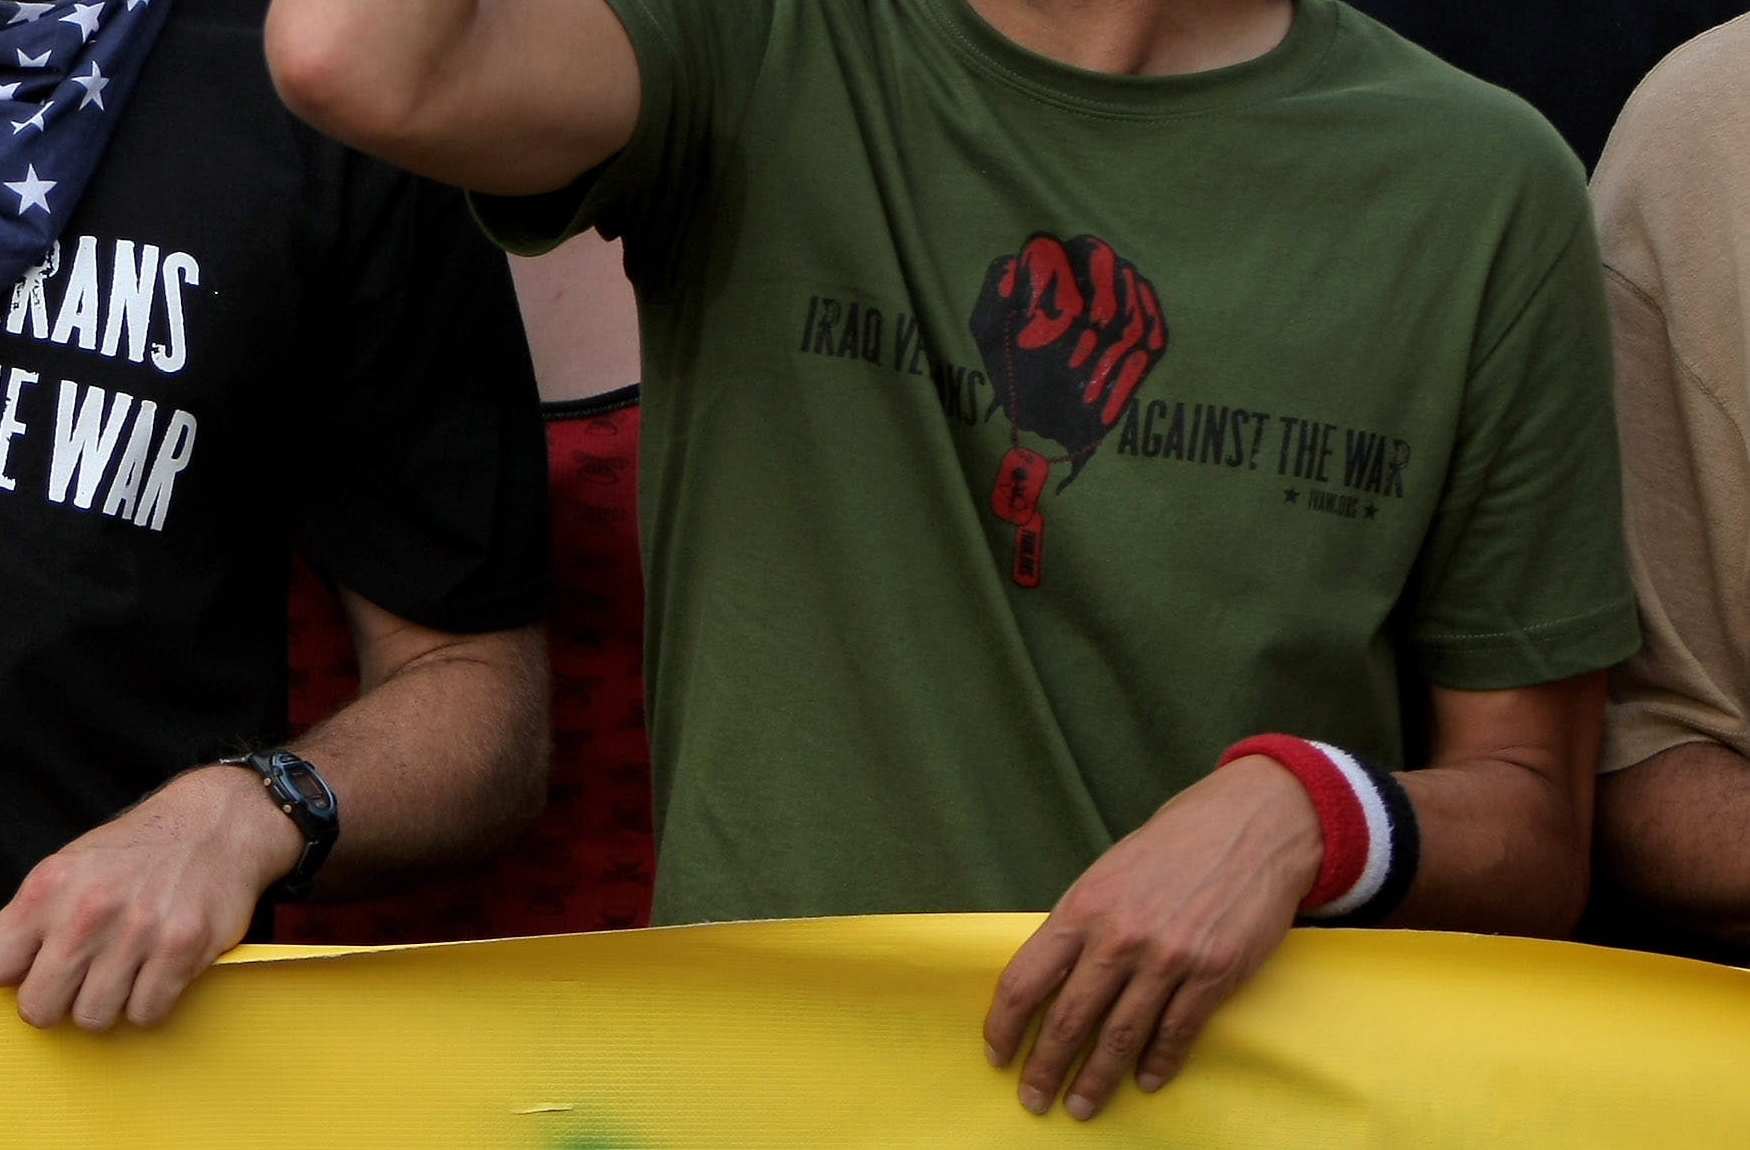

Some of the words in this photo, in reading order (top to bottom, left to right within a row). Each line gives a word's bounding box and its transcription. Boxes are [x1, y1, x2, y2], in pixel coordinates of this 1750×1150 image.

[800, 295, 885, 367] IRAQ
[47, 379, 199, 532] WAR
[1116, 396, 1270, 471] AGAINST
[1278, 415, 1337, 483] THE
[1343, 428, 1412, 499] WAR
